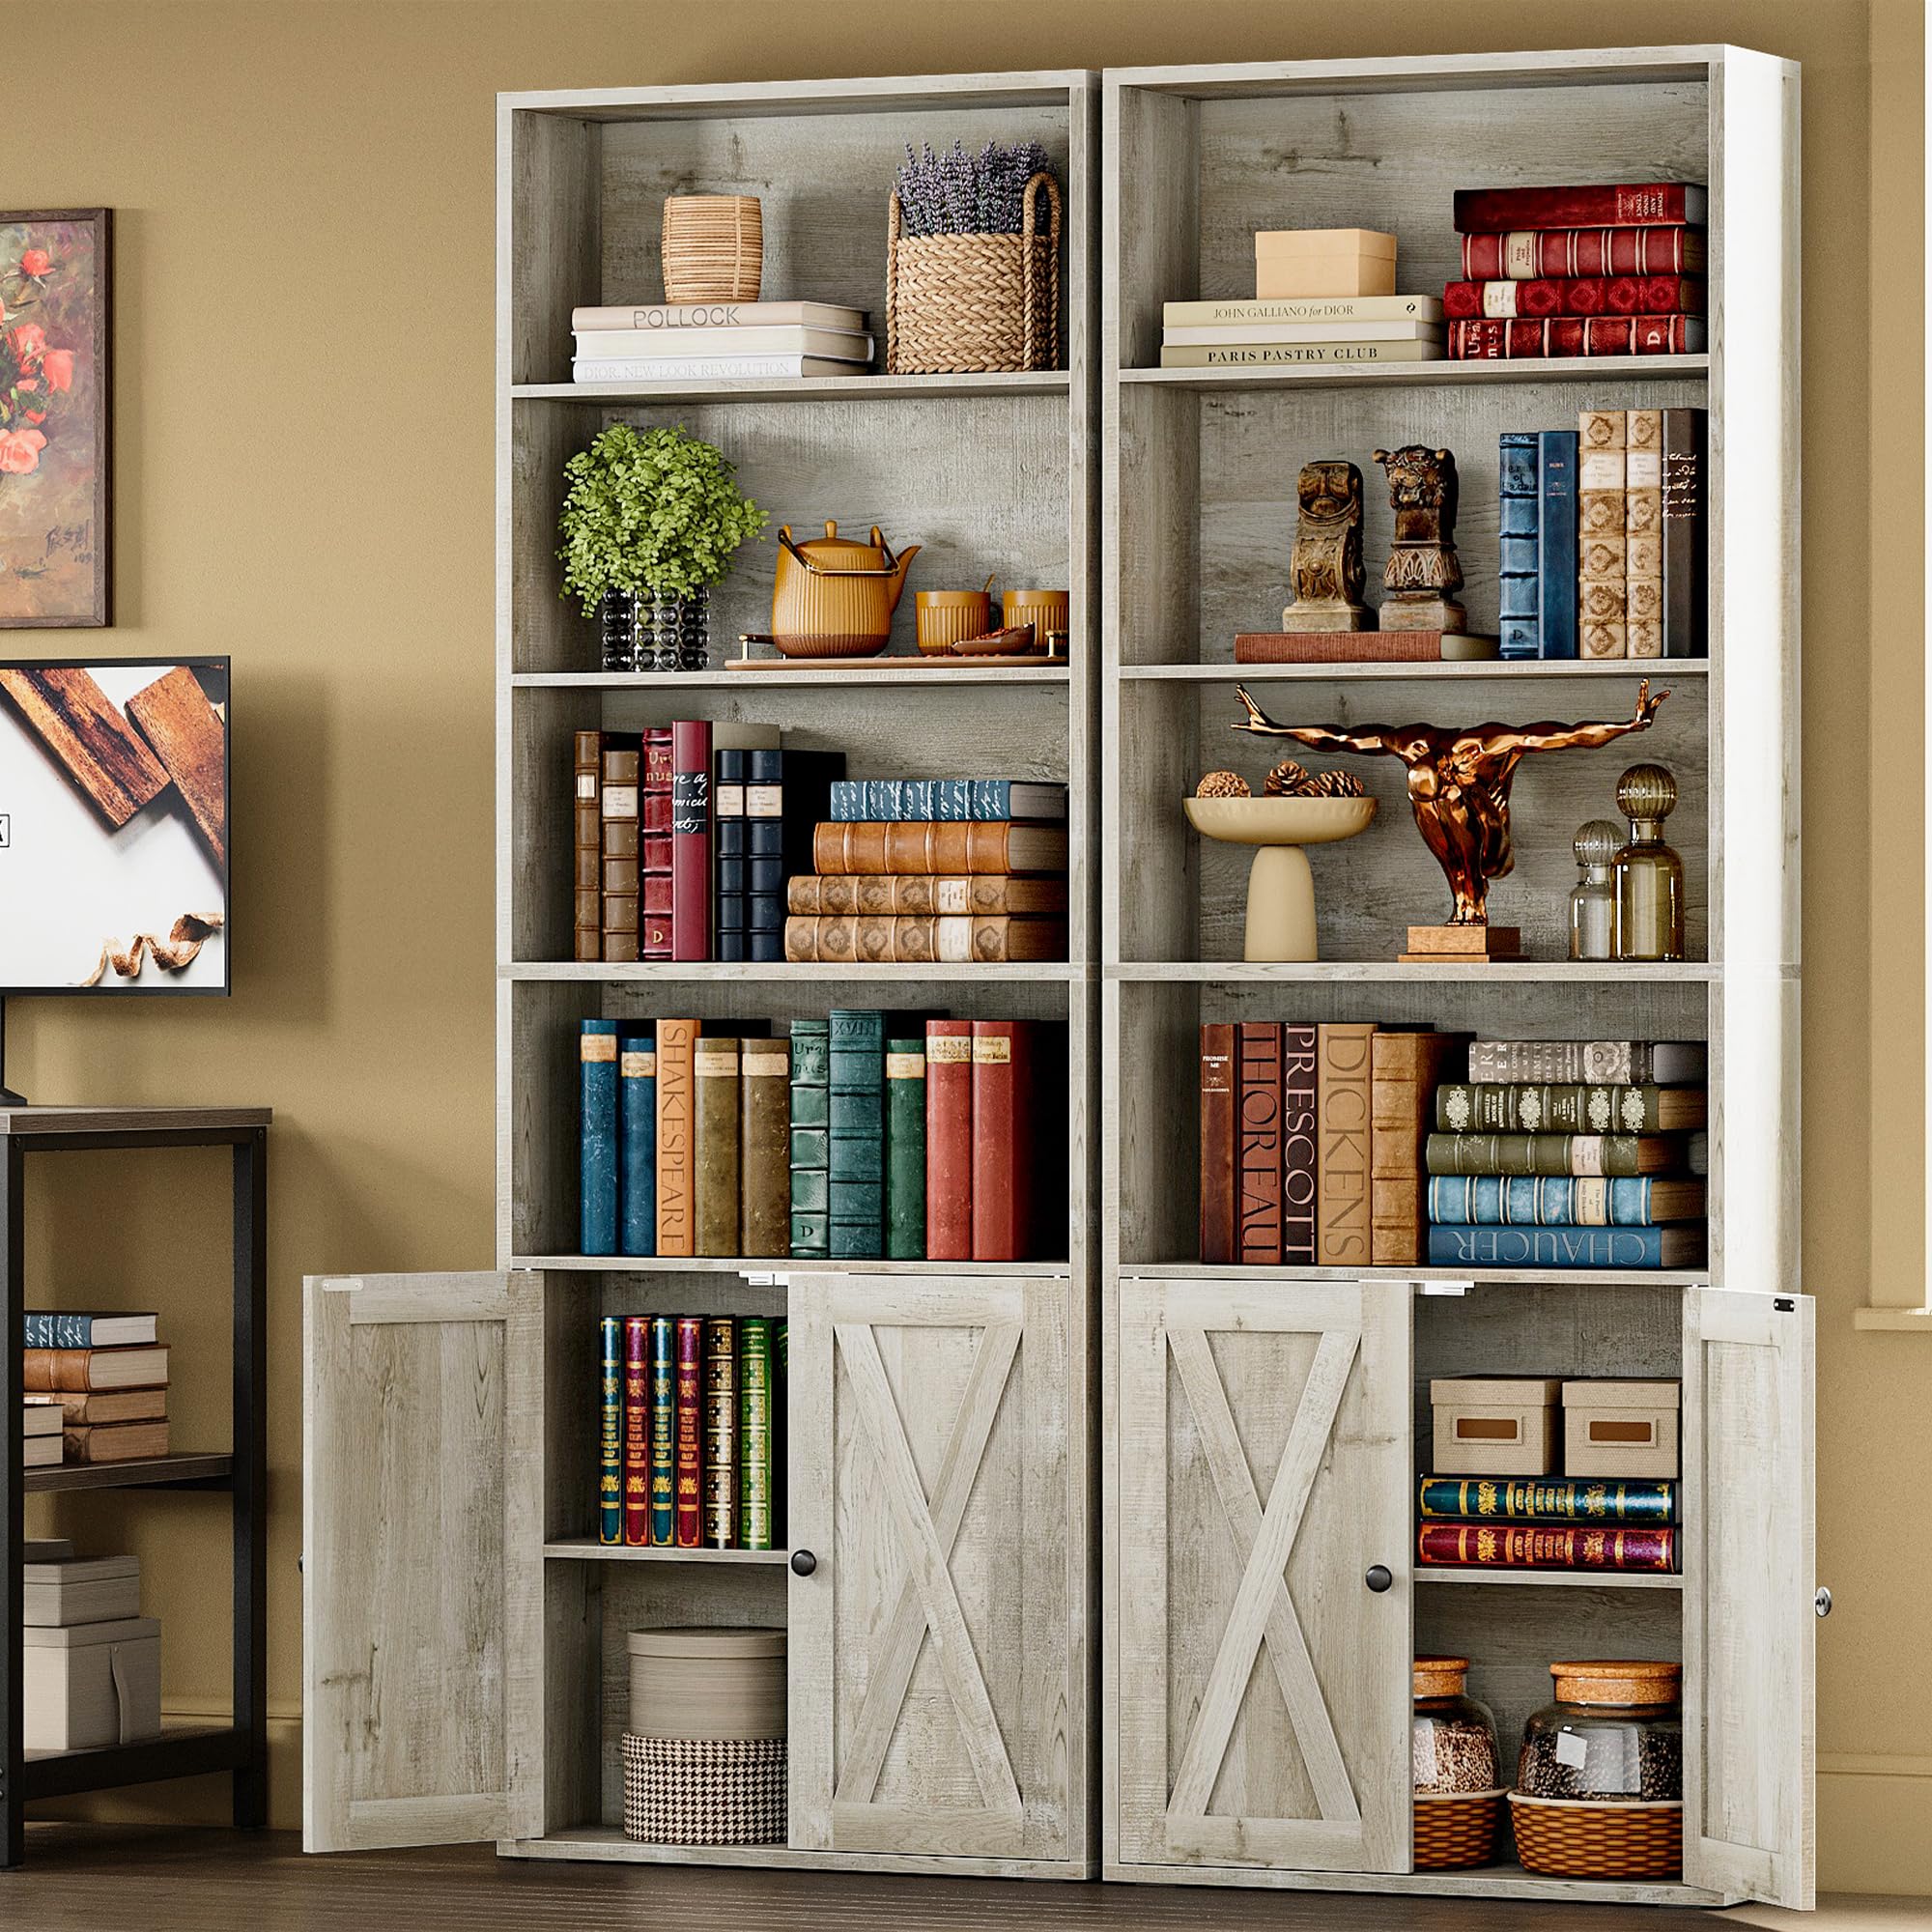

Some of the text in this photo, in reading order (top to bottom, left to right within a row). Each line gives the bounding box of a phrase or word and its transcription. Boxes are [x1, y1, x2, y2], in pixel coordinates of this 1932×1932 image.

[633, 306, 740, 328] POLLOCK
[1213, 304, 1354, 319] JOHN GALLIANO for DIOR
[1646, 331, 1661, 346] D
[1208, 347, 1378, 362] PARIS PASTRY CLUB
[624, 363, 658, 379] NEW
[659, 362, 697, 378] LOOK
[700, 360, 790, 377] REVOLUTION
[652, 930, 664, 944] D
[661, 1026, 688, 1250] SHAKESPEARE
[1242, 1026, 1278, 1252] THOREAU
[1285, 1027, 1316, 1263] PRESCOTT
[1323, 1035, 1367, 1257] DICKENS
[800, 1225, 813, 1238] D
[1449, 1230, 1647, 1265] CHAUCER
